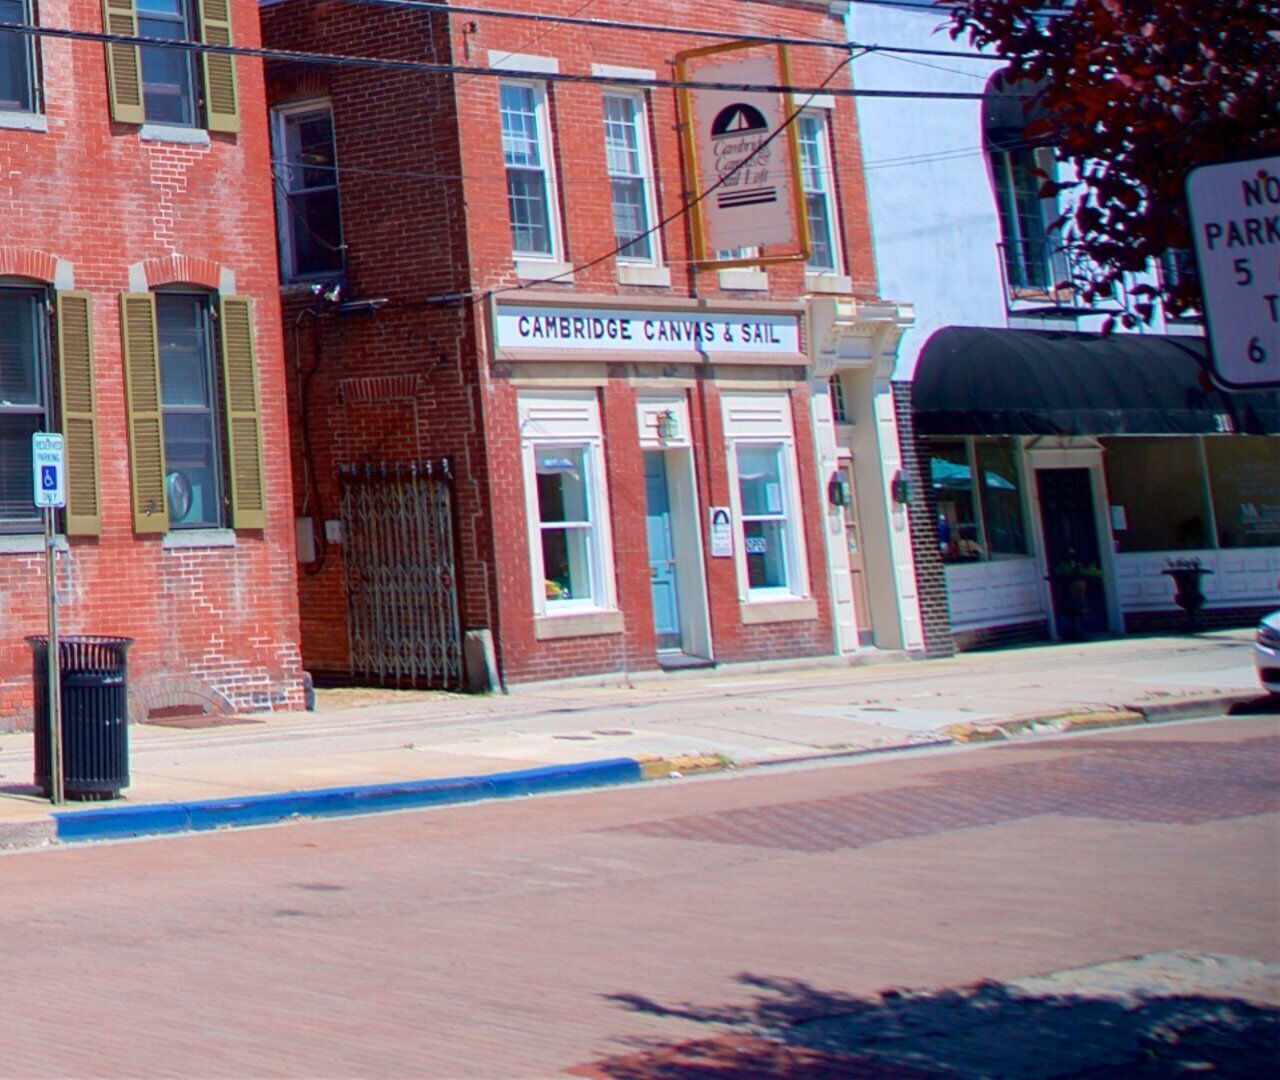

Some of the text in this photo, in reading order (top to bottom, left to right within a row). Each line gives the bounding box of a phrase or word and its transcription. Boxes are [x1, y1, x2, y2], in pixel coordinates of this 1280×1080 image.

[1242, 176, 1280, 207] NO
[1233, 257, 1253, 287] 5
[518, 315, 781, 344] CAMBRIDGE CANVAS & SAIL
[1247, 335, 1267, 364] 6
